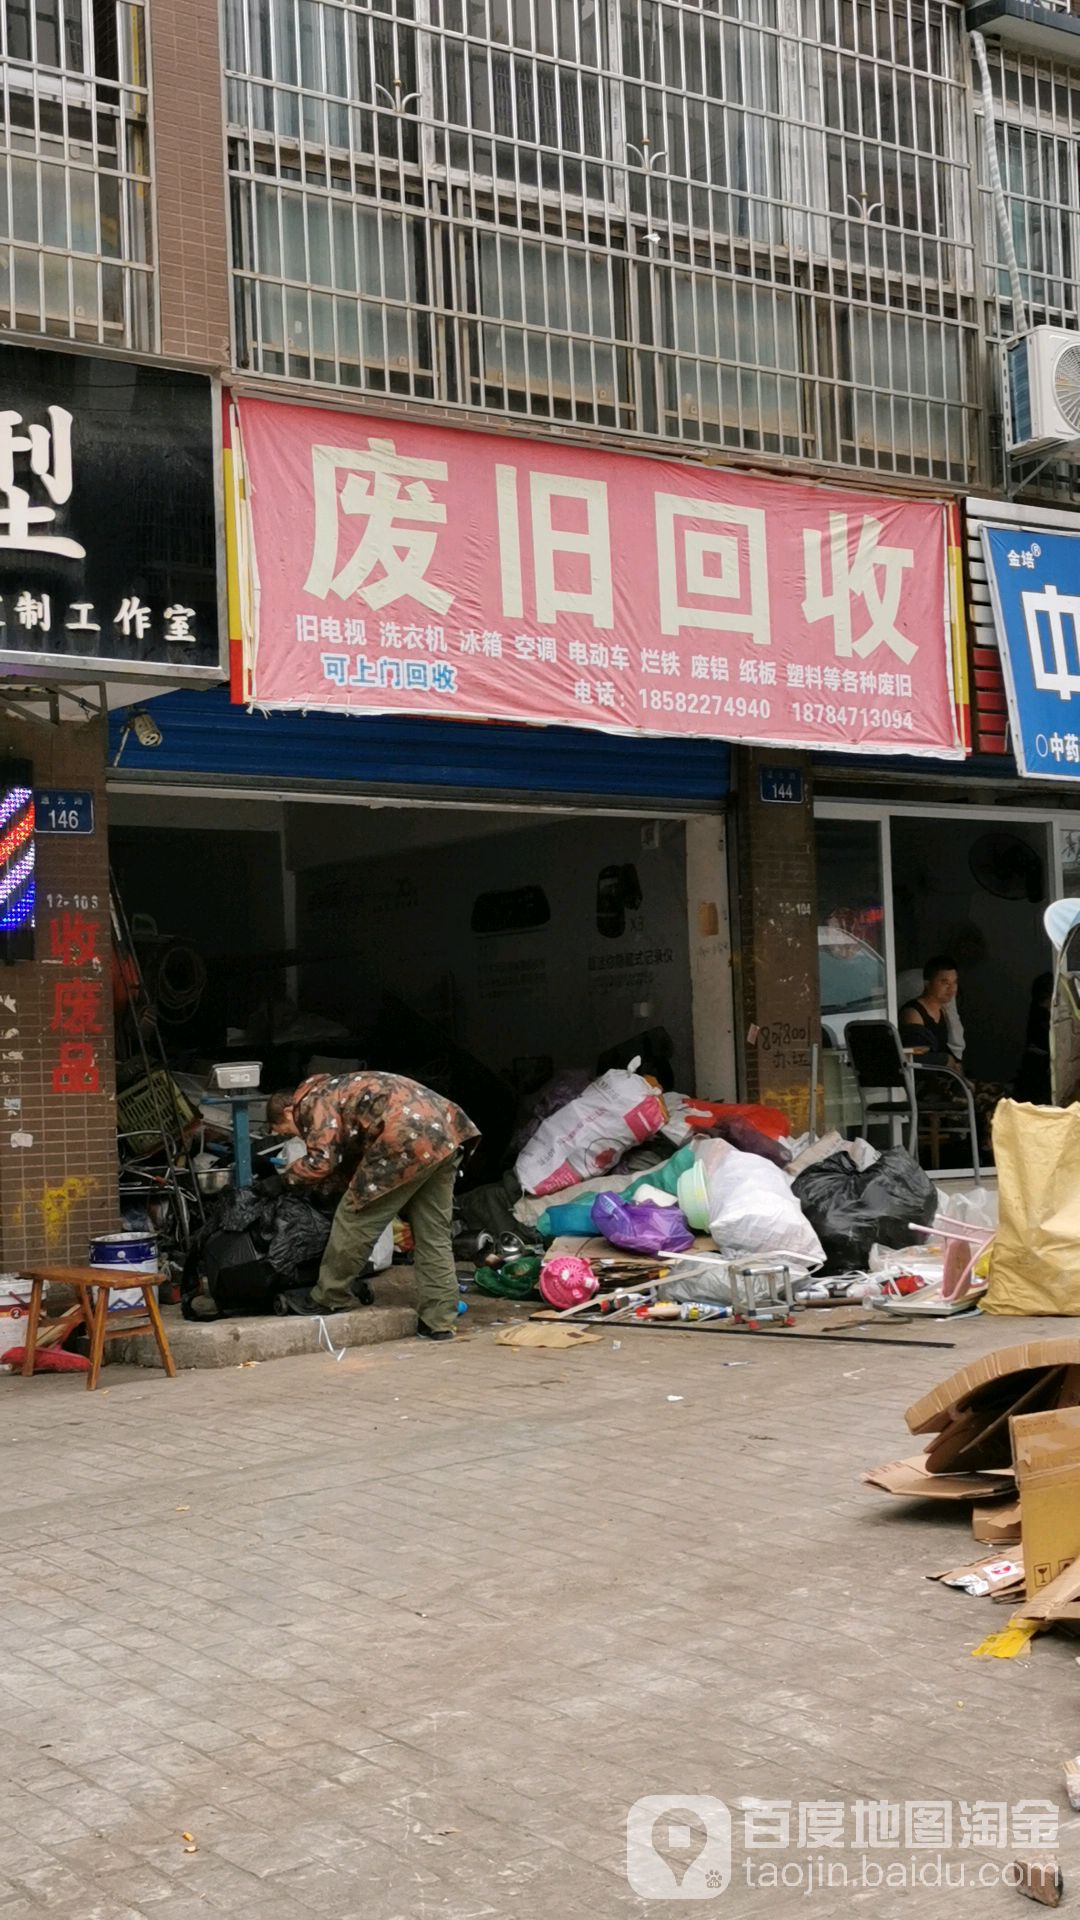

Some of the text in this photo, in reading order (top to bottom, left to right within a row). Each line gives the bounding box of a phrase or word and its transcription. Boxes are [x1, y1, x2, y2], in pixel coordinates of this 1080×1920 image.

[0, 405, 86, 559] 型
[303, 438, 918, 665] 废旧回收
[0, 591, 196, 642] 制工作室
[1021, 584, 1080, 701] 中
[296, 614, 913, 698] 旧电视 洗衣机 冰箱 空调 电动车 烂铁 废铝 纸板 塑料等各种废旧
[320, 653, 457, 693] 可上门回收
[639, 688, 770, 719] 18582274940
[792, 702, 913, 730] 18784713094
[48, 809, 79, 829] 146
[772, 783, 793, 799] 144
[49, 911, 102, 1093] 收废品
